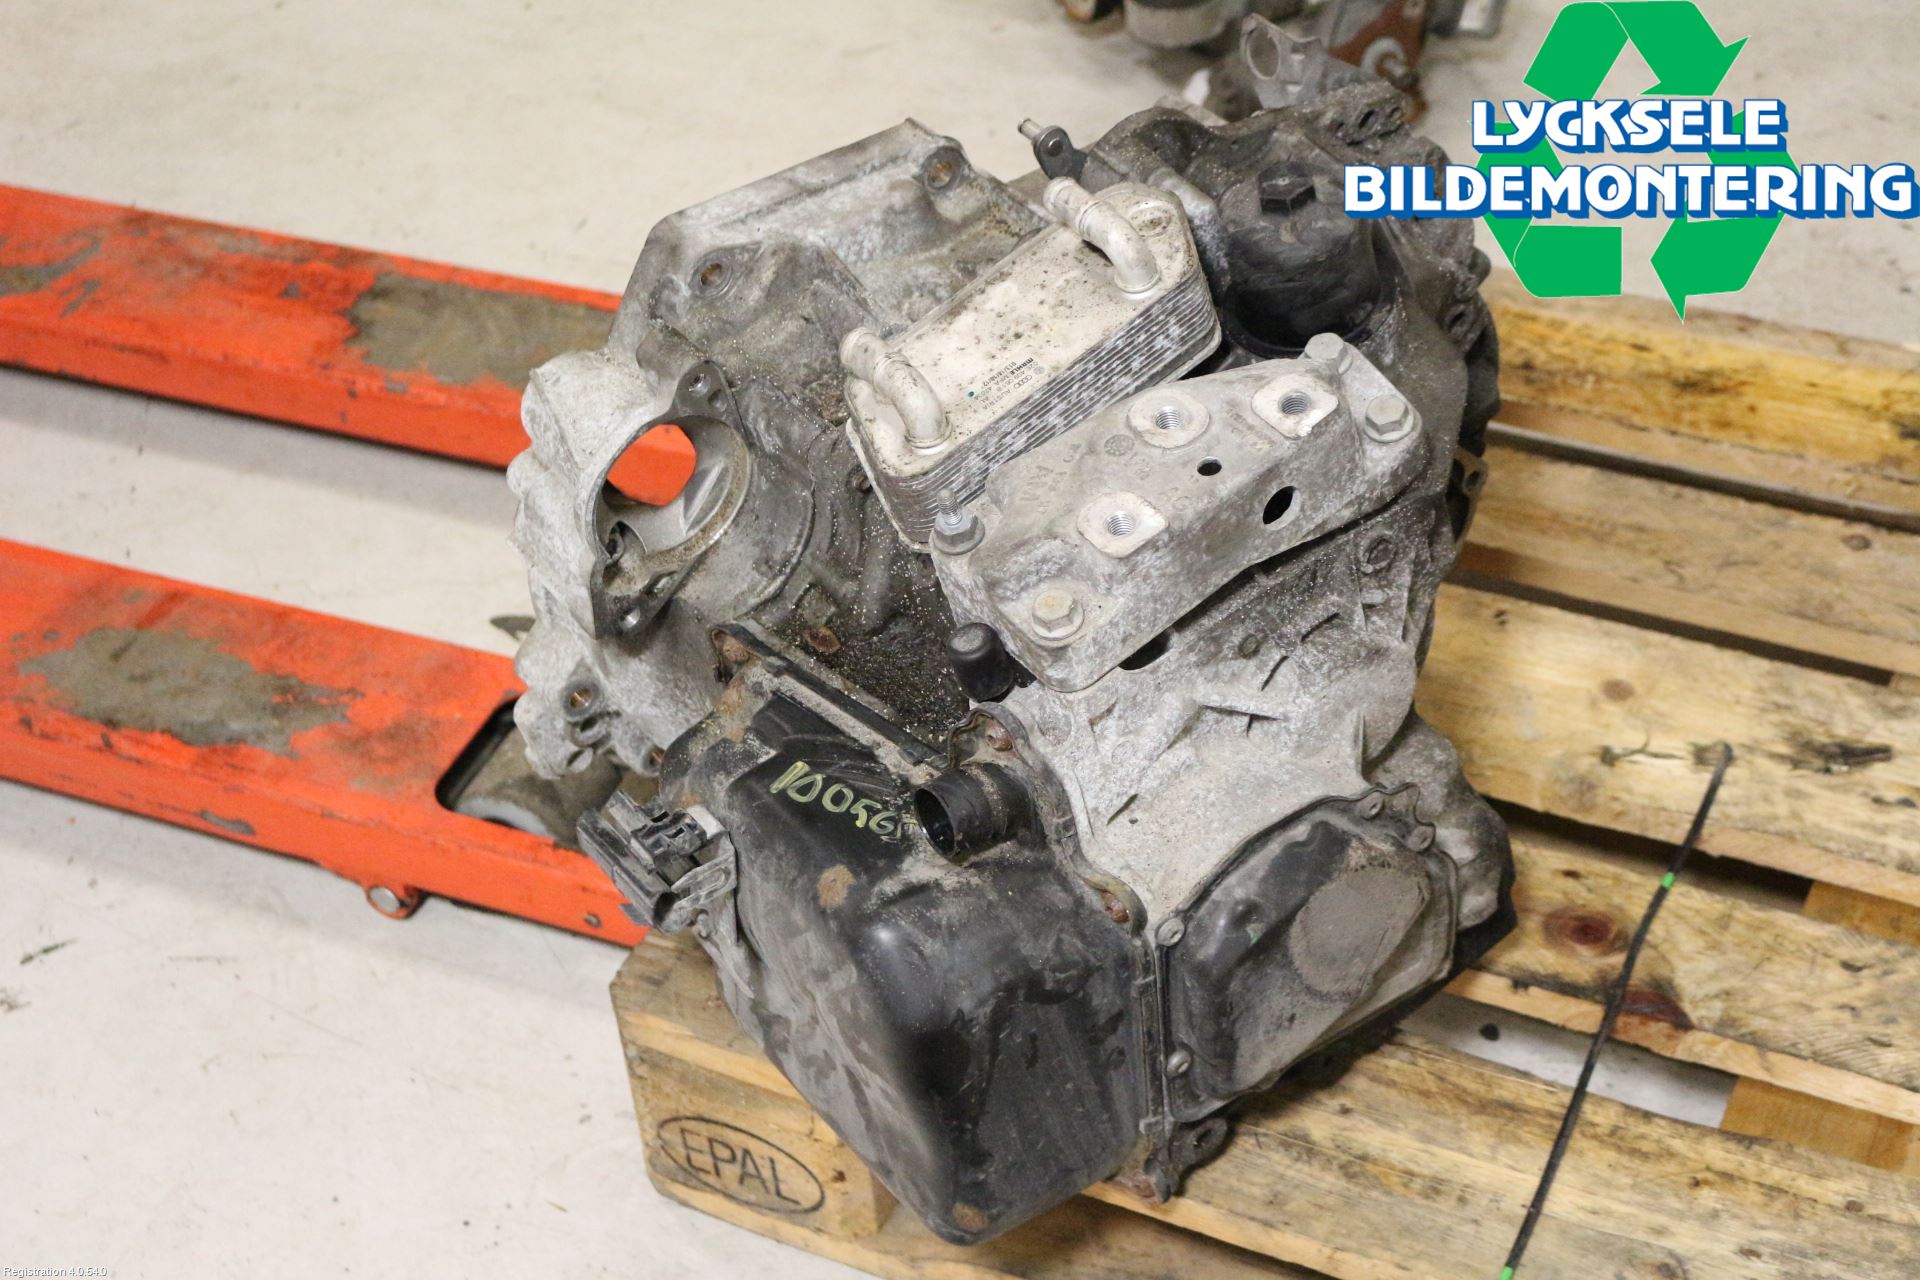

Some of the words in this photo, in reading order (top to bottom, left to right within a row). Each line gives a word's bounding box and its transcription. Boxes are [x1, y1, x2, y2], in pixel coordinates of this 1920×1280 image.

[1009, 357, 1034, 375] MAHLE
[982, 388, 1010, 410] AUSTRIA
[679, 1127, 802, 1206] EPAL
